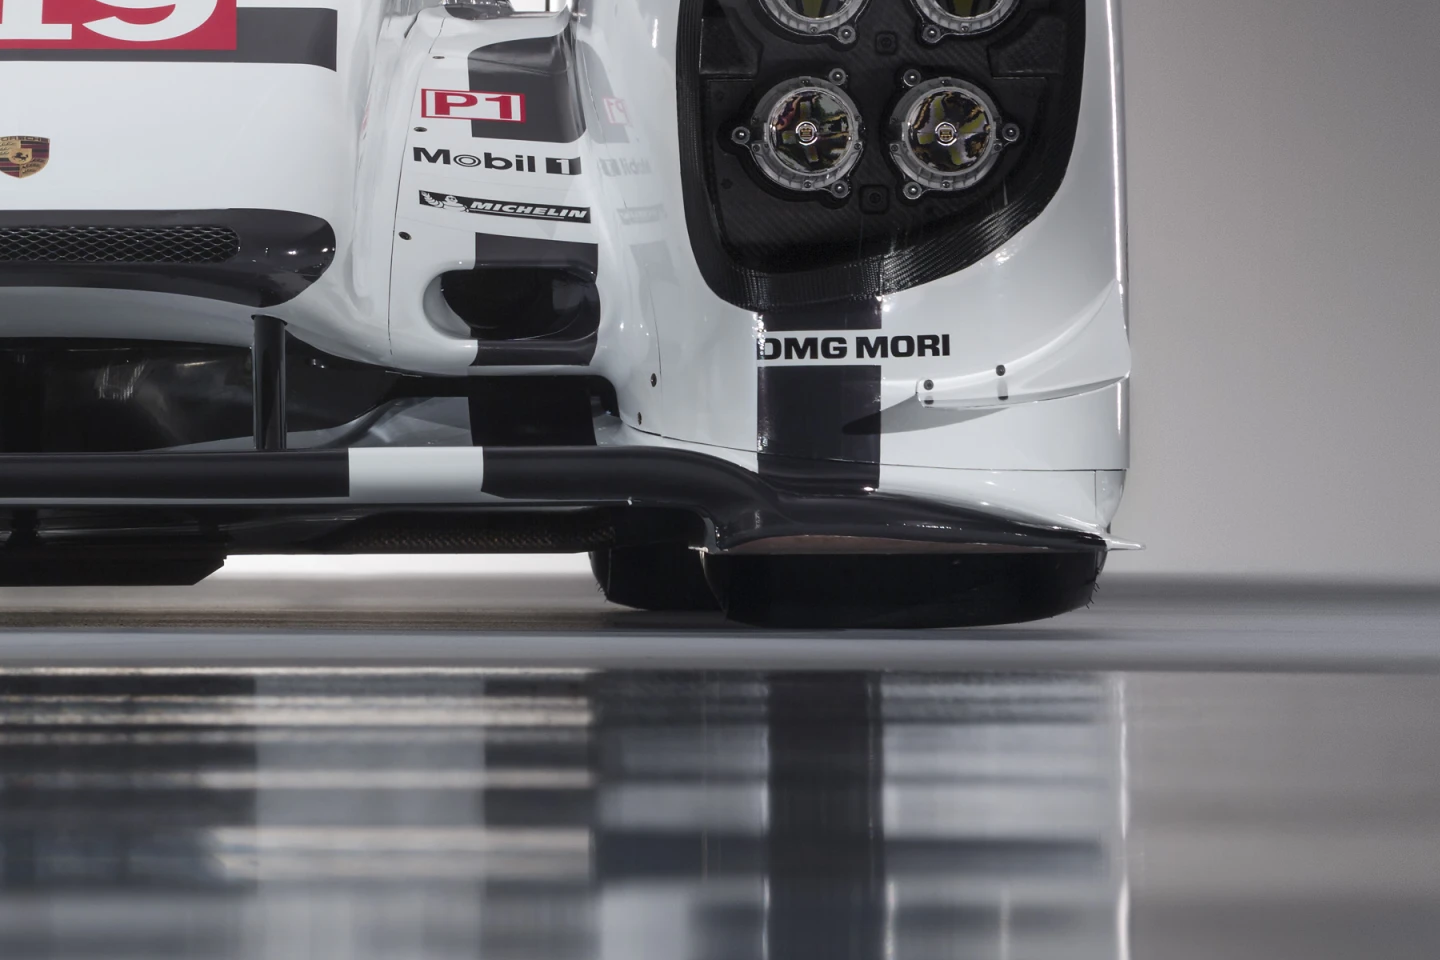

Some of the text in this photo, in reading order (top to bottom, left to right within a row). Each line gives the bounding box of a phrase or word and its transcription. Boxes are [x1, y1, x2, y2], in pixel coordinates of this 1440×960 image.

[434, 91, 513, 120] P1
[412, 146, 537, 173] Mobil
[469, 200, 588, 219] MICHELIN
[756, 333, 951, 360] DMG MORI
